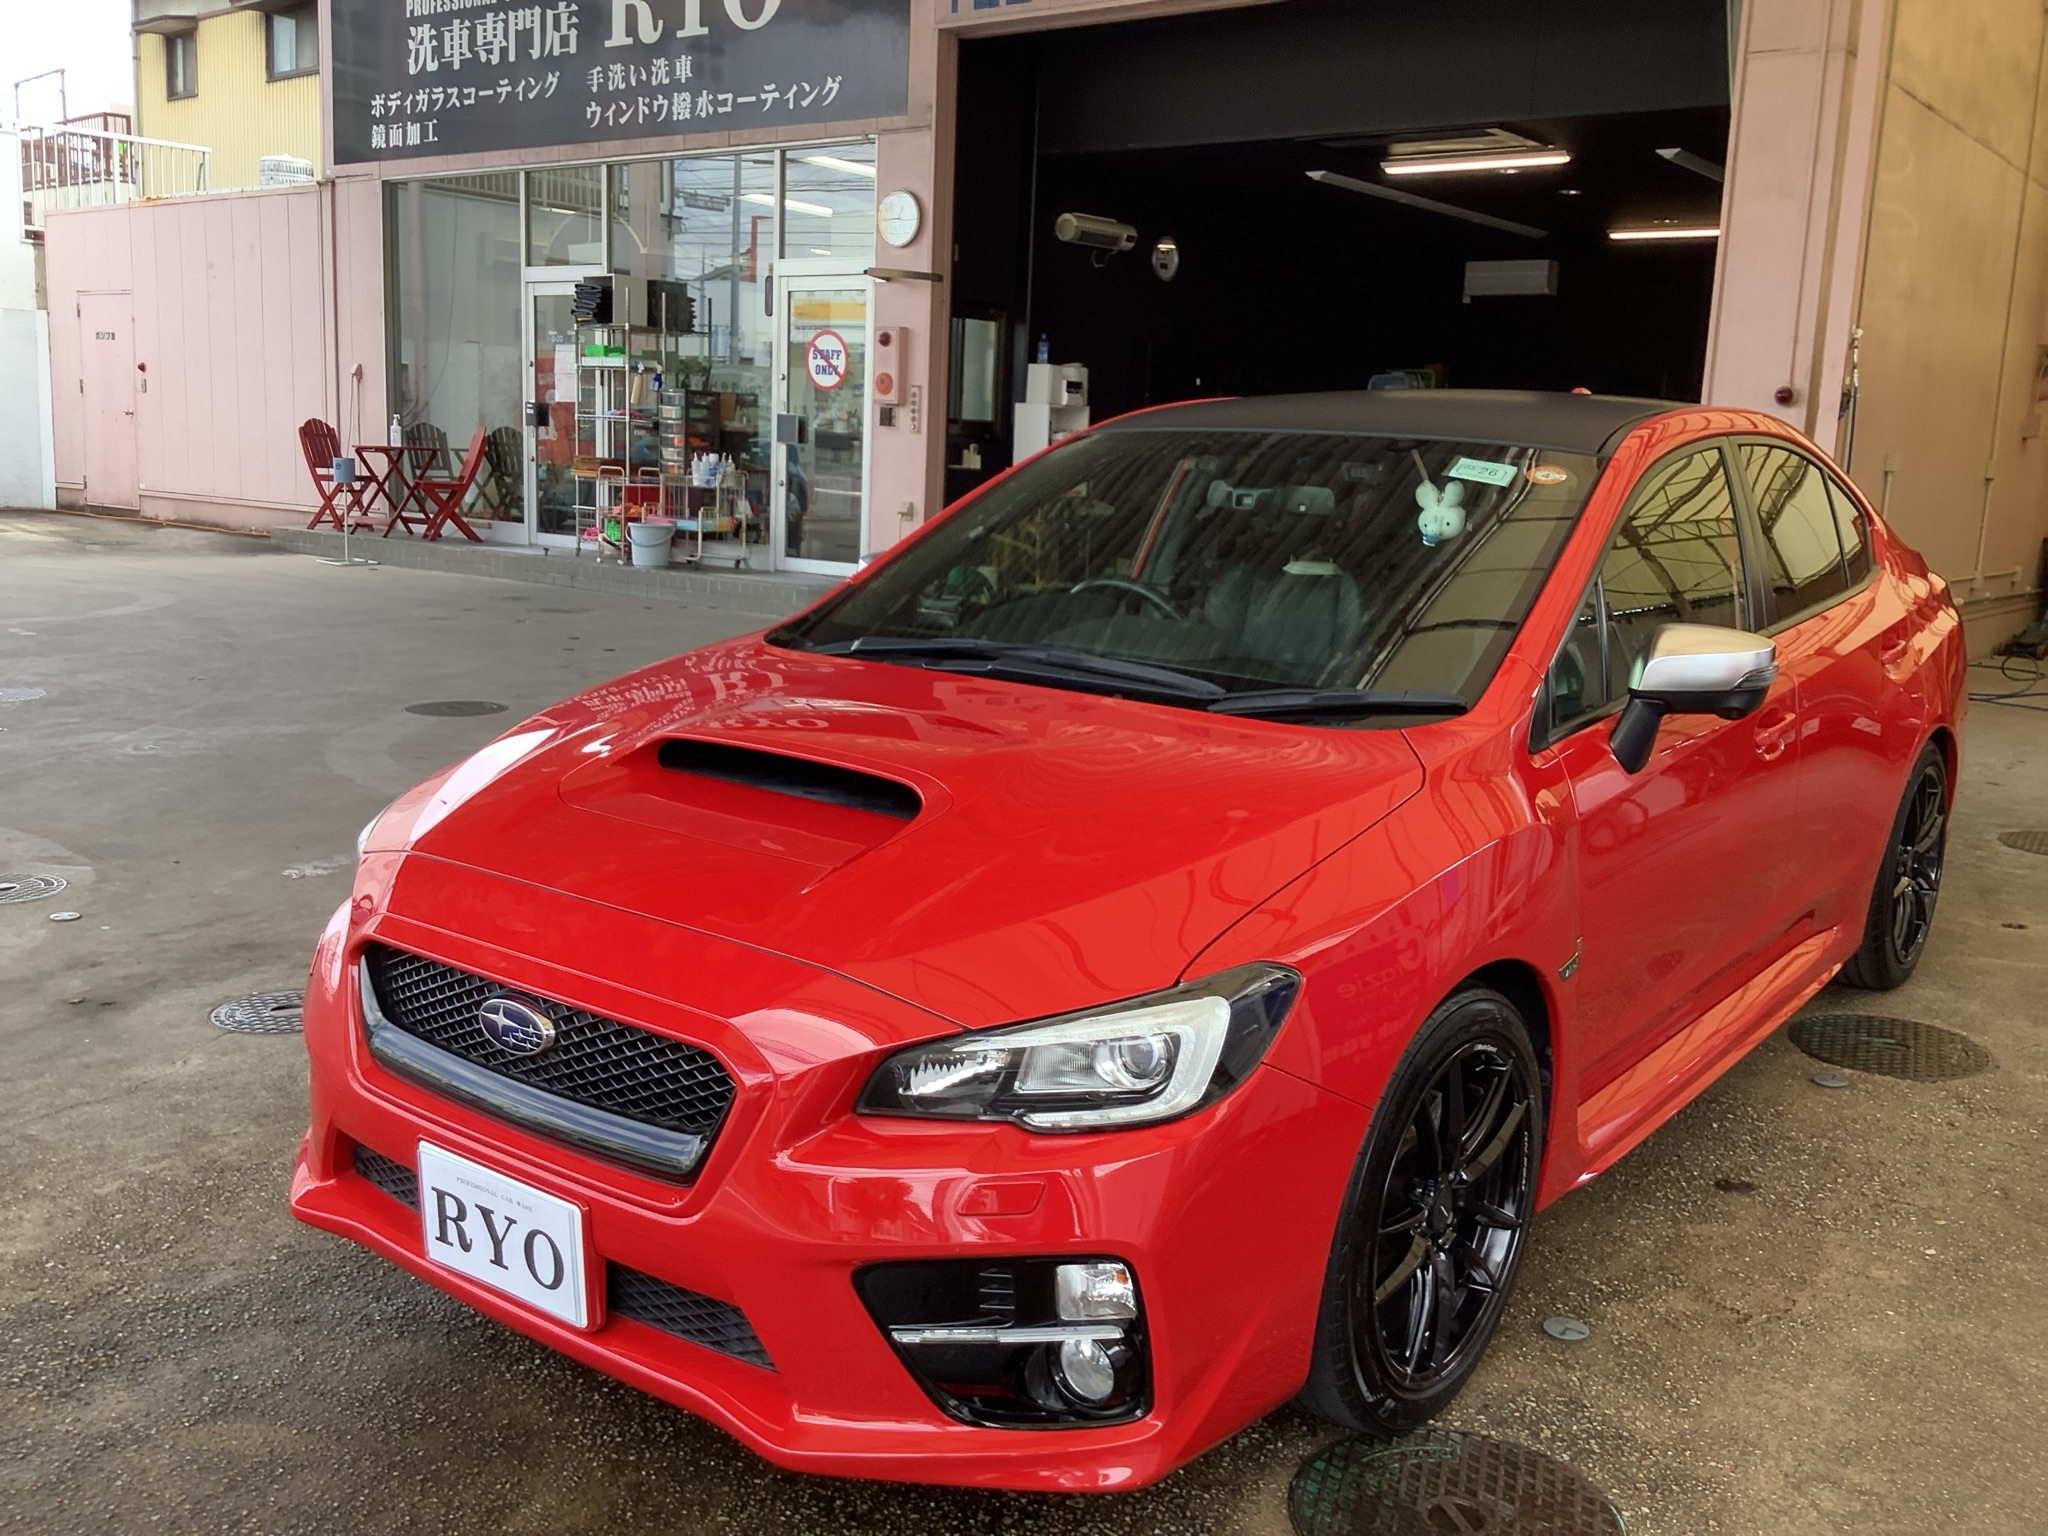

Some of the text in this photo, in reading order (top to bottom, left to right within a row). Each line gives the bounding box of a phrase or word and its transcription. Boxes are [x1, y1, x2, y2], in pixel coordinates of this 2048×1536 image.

[406, 0, 497, 18] PROFESS
[407, 1, 579, 75] 洗車専門店
[586, 55, 693, 93] 手洗い洗車
[371, 71, 560, 118] ボディガラスコーティング
[586, 75, 842, 128] ウィンドウ撥水コーティング
[371, 119, 438, 149] 鏡面加工
[812, 349, 842, 360] STAFF
[815, 364, 839, 376] ONLY
[1478, 467, 1499, 477] 26
[431, 1186, 564, 1290] RYO
